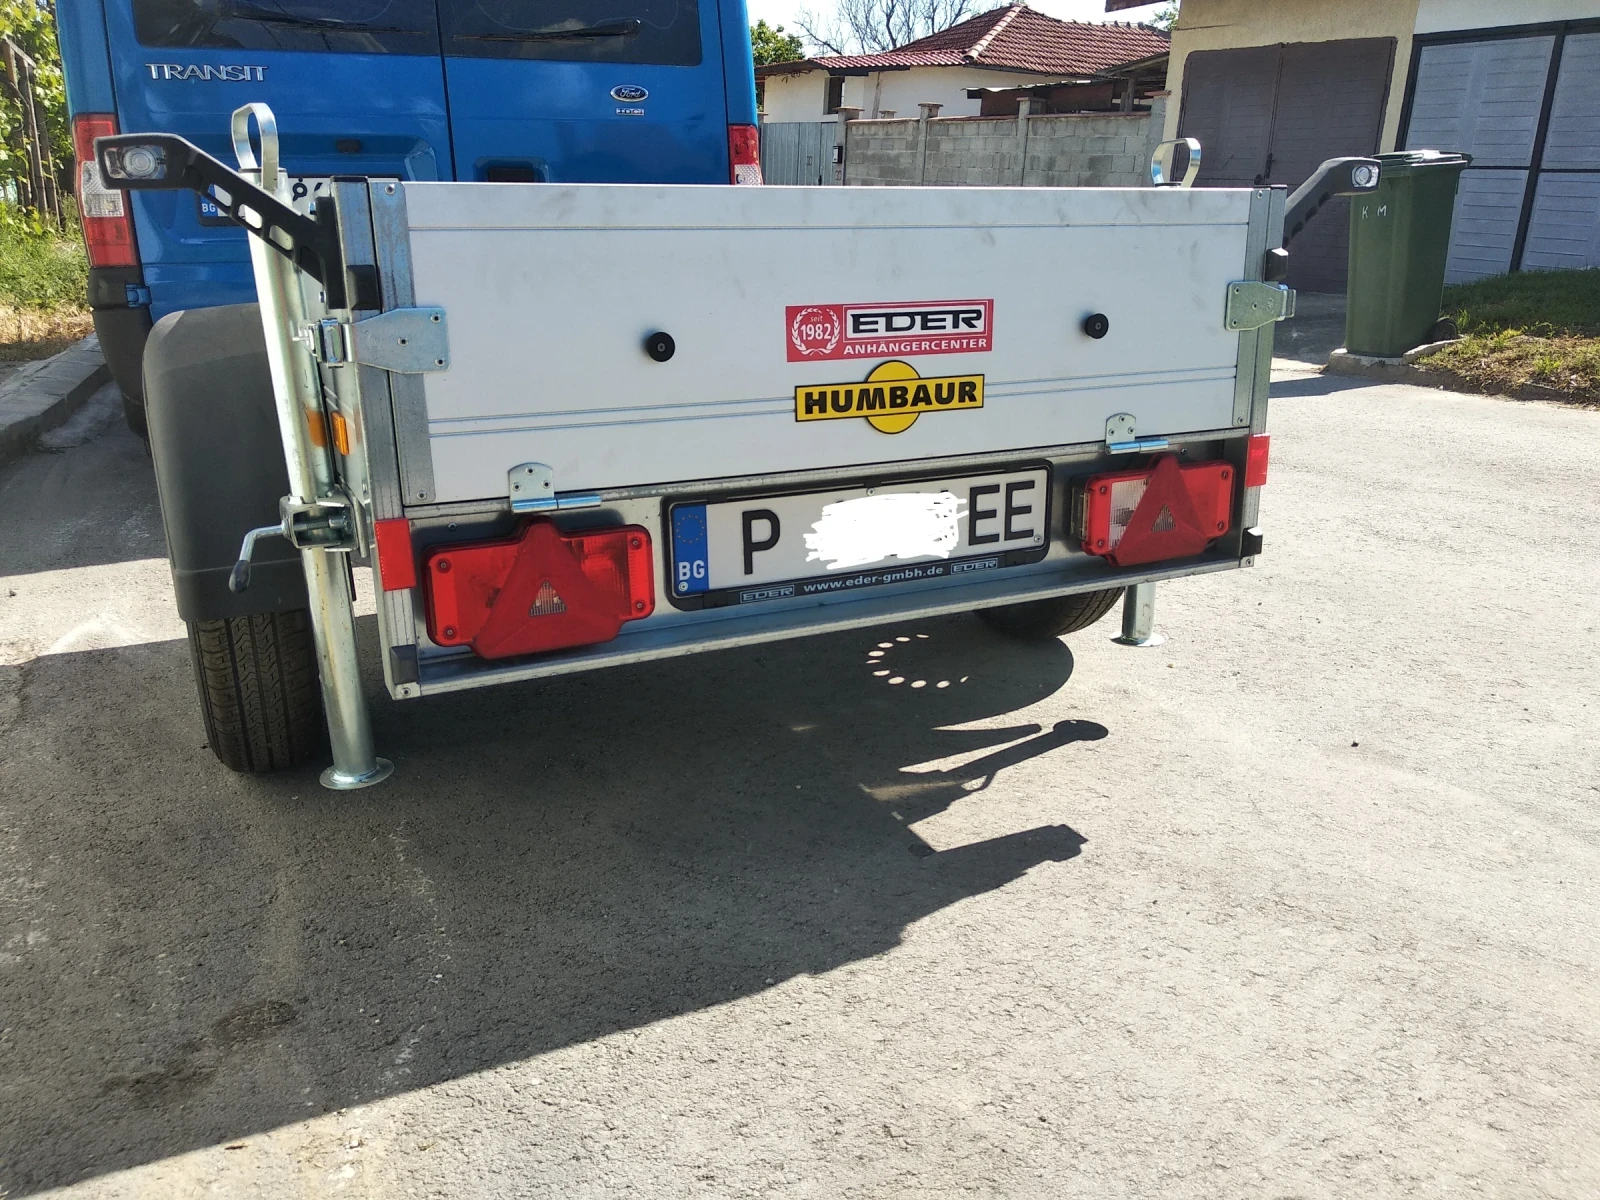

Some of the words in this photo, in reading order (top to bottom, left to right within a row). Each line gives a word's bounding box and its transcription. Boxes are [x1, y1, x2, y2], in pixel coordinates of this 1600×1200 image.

[145, 63, 268, 81] TRANSIT
[619, 87, 641, 98] Ford
[201, 203, 216, 213] BG
[810, 315, 823, 323] seit
[850, 309, 982, 333] EDER
[800, 323, 832, 341] 1982
[843, 338, 987, 355] ANHÄNGERCENTER
[804, 381, 977, 415] HUMBAUR
[742, 509, 781, 575] P
[678, 560, 705, 581] BG
[743, 588, 793, 601] EDER
[803, 566, 944, 593] www.eder-gmbh.de
[952, 560, 997, 573] EDER
